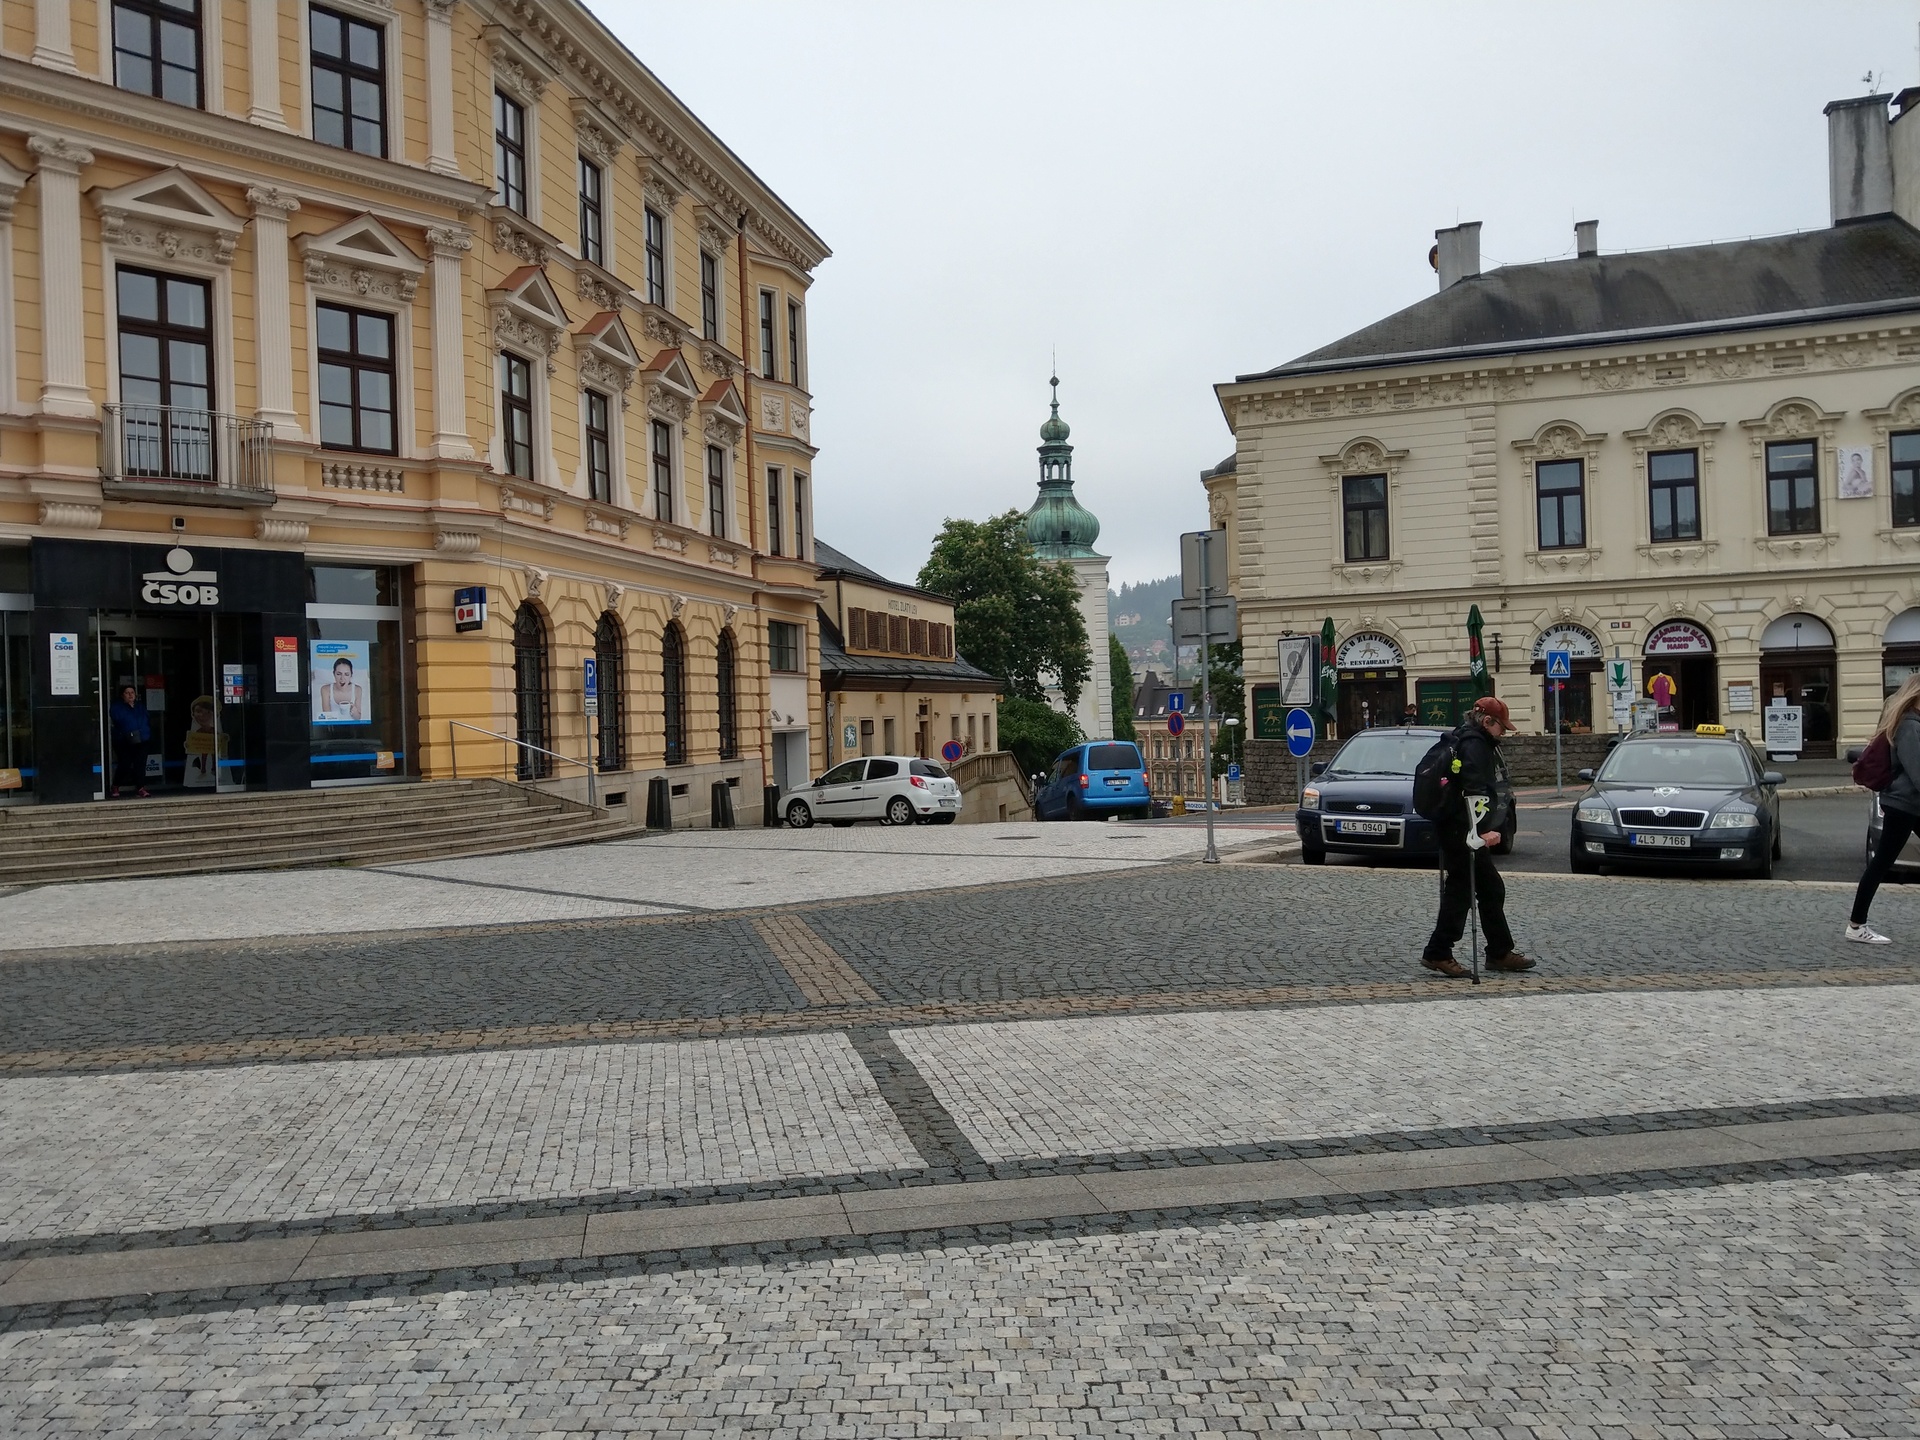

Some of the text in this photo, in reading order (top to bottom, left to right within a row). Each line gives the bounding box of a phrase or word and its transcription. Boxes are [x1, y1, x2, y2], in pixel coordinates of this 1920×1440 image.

[142, 581, 219, 606] ČSOB
[1662, 635, 1694, 643] SECOND
[587, 663, 594, 685] P
[1780, 712, 1798, 721] 3D
[1231, 766, 1237, 776] P
[1342, 822, 1383, 832] 4L5 0940
[1638, 835, 1686, 846] 4L3 7166
